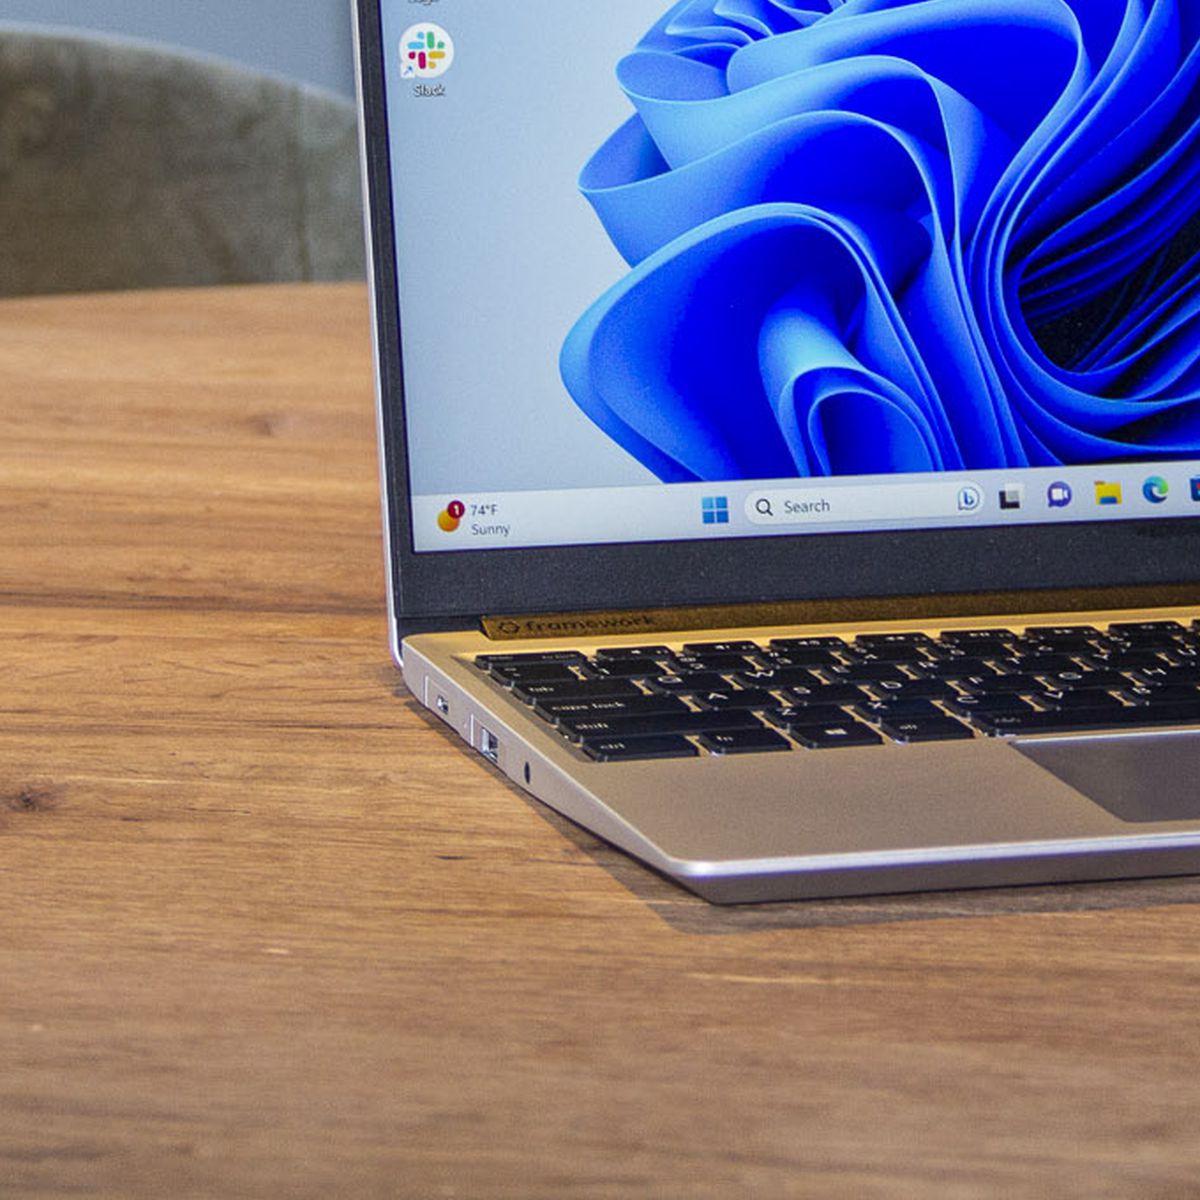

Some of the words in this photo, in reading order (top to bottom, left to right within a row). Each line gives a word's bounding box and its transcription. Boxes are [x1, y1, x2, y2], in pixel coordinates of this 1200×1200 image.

[414, 84, 445, 97] Slack
[471, 504, 498, 516] 74°F
[783, 499, 830, 514] Search
[471, 524, 510, 537] Sunny
[526, 615, 657, 632] framework
